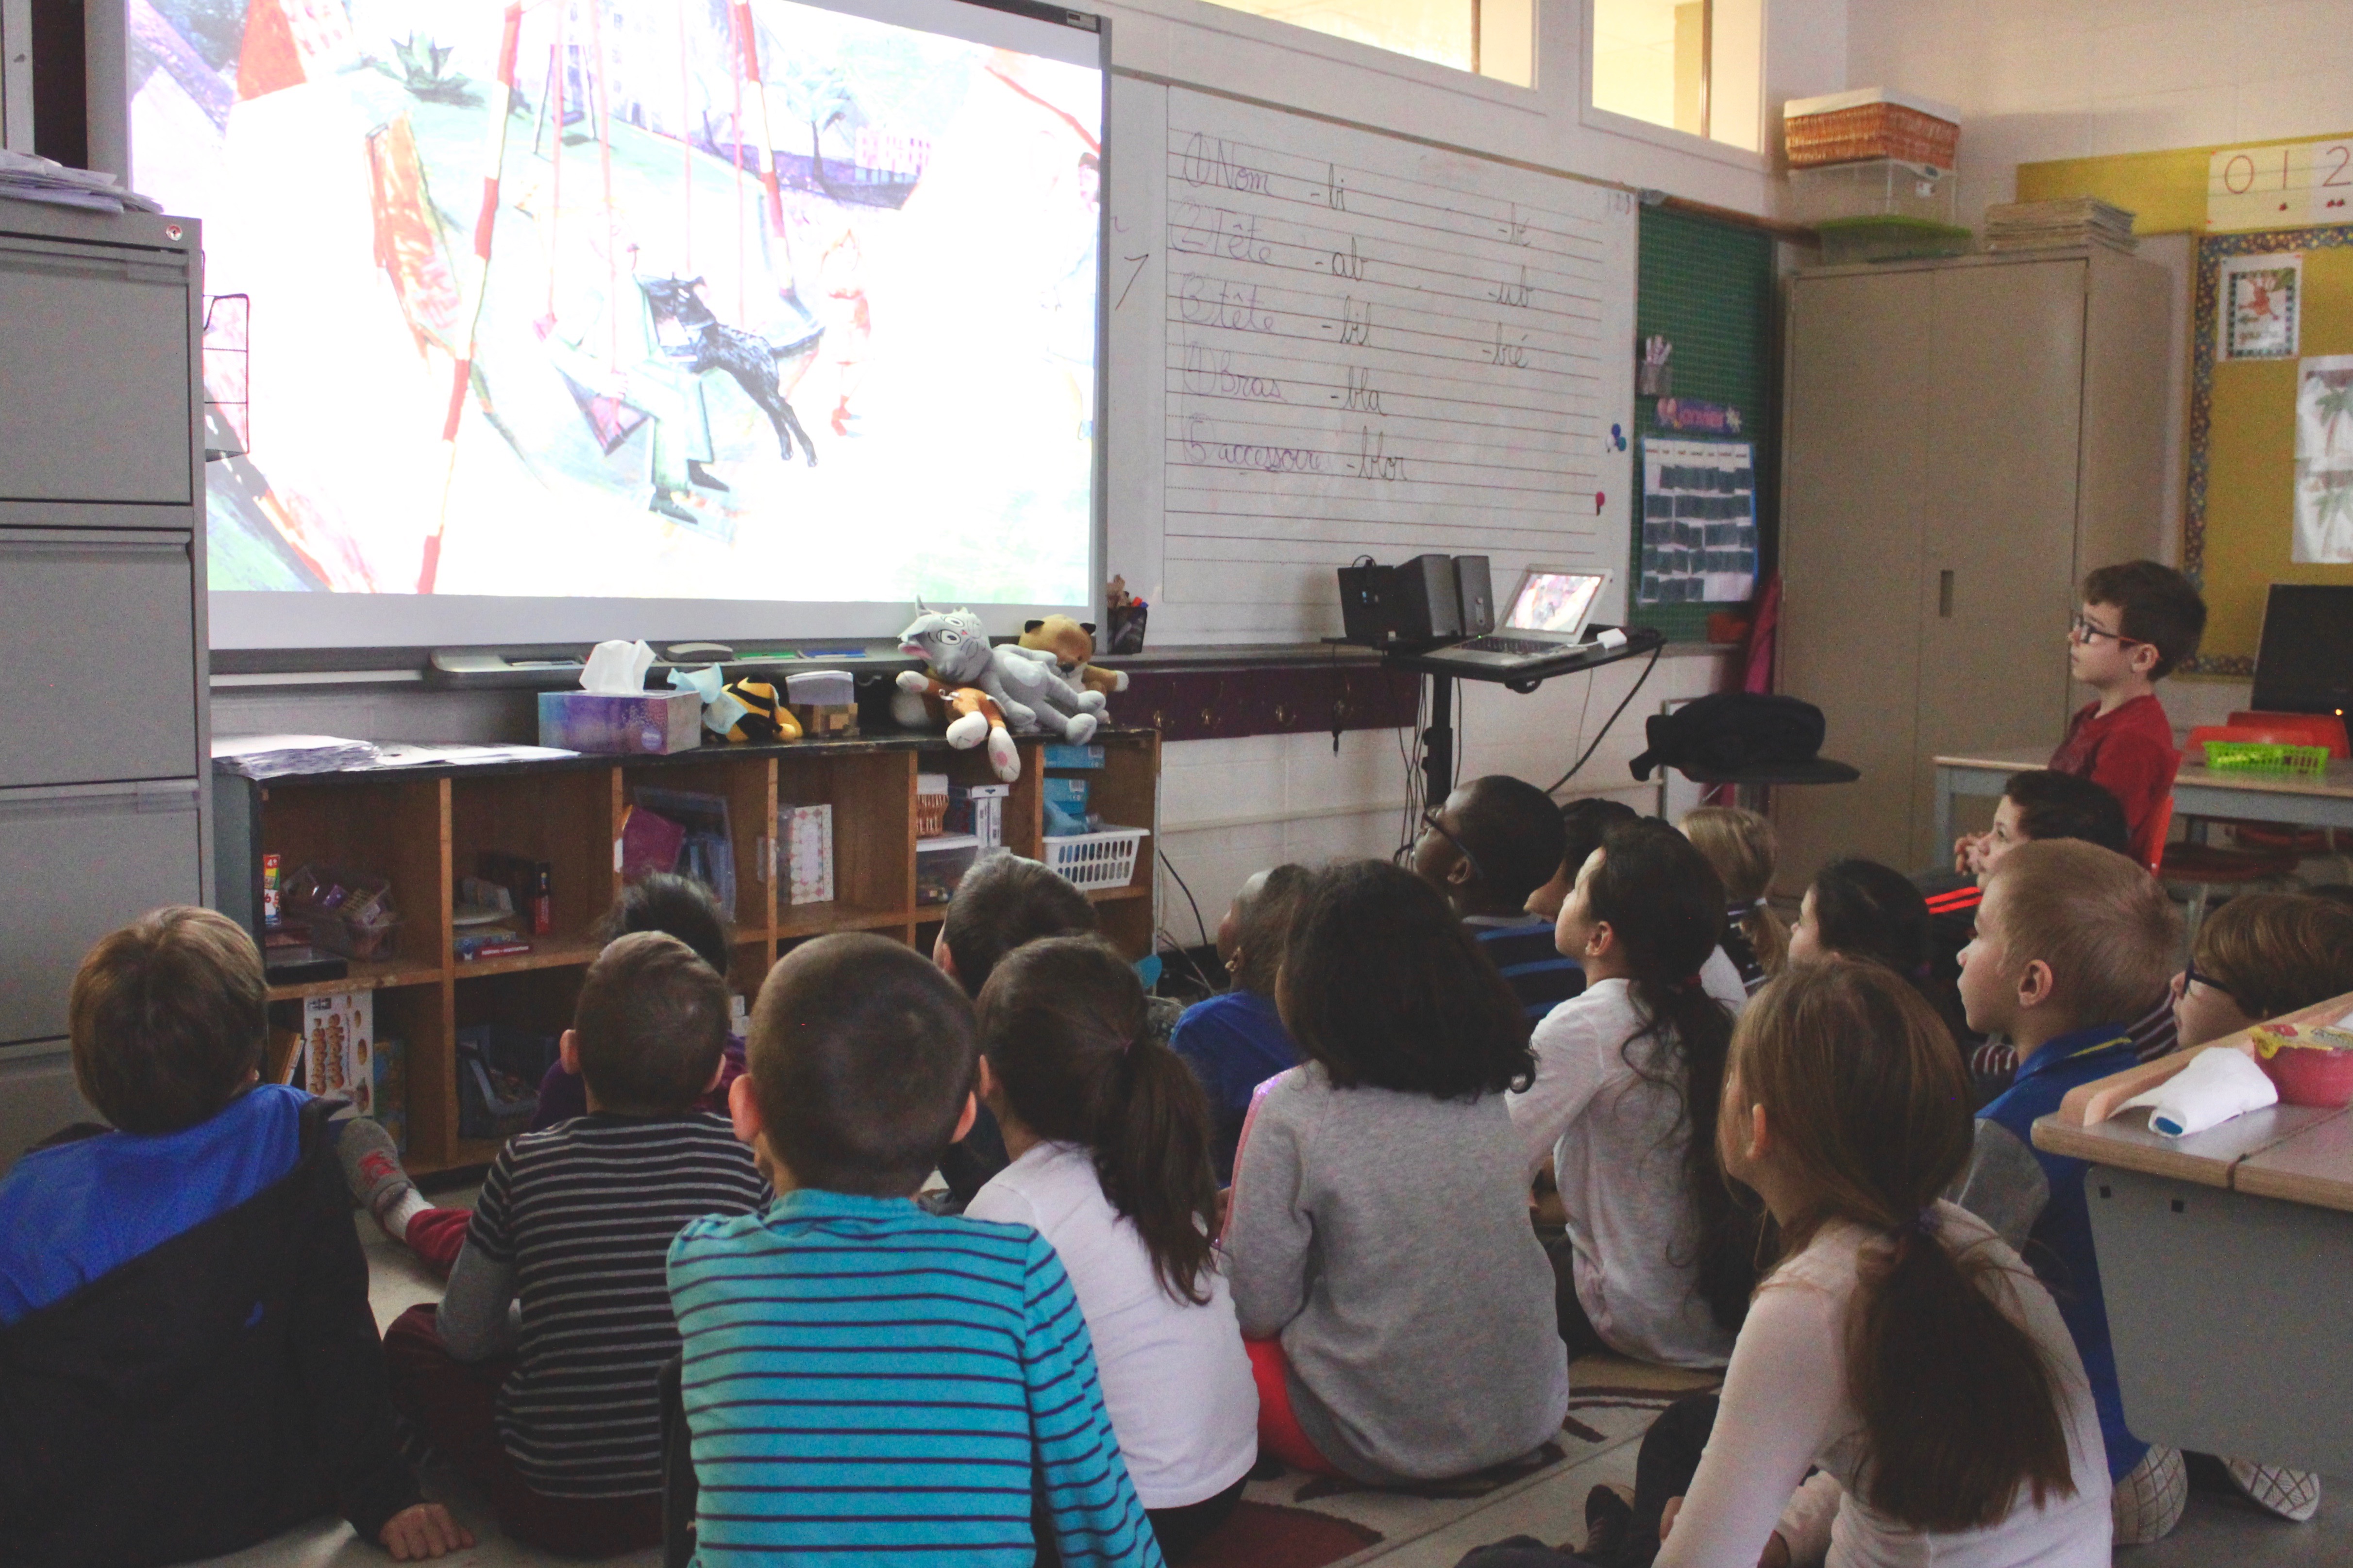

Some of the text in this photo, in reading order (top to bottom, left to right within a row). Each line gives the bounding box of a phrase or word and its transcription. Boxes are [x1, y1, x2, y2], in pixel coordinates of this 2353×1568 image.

[1216, 139, 1272, 195] Nom
[2224, 146, 2352, 194] 0 1 2
[1214, 207, 1270, 265] Tête
